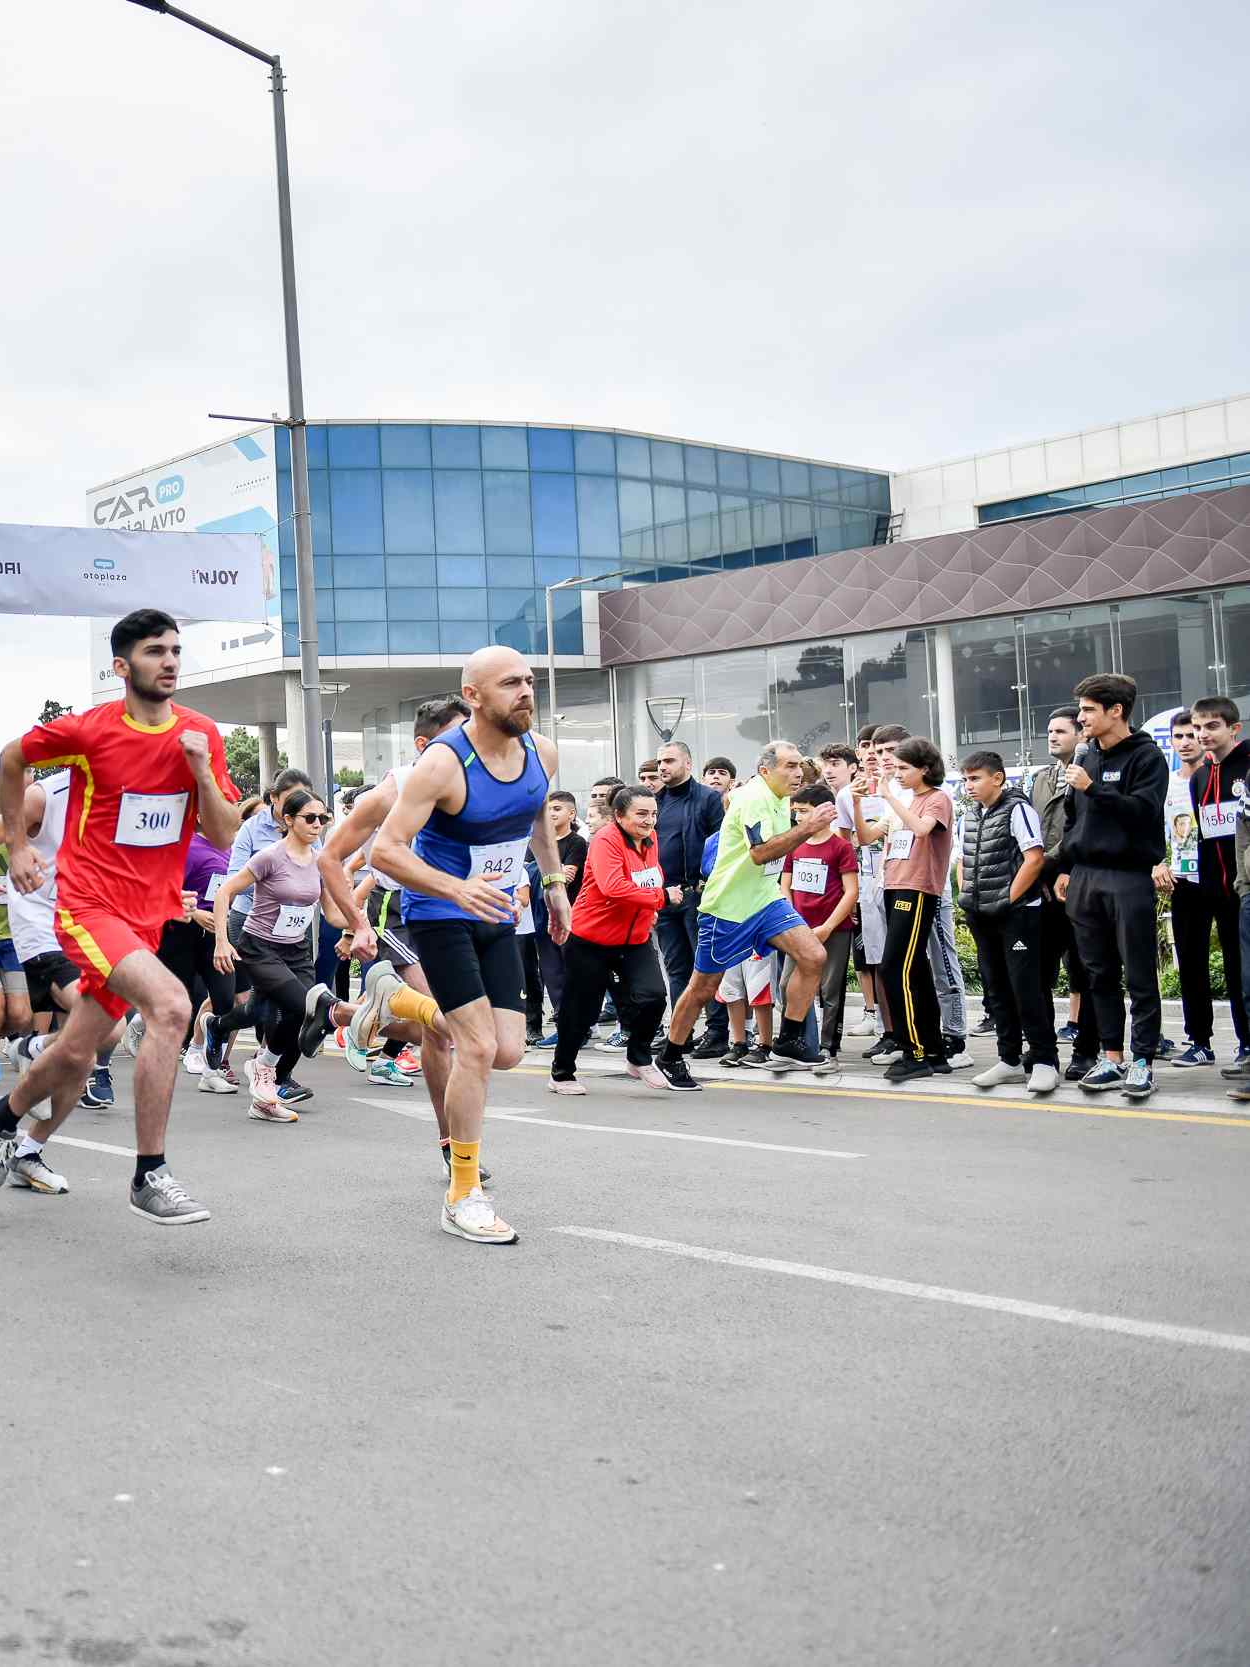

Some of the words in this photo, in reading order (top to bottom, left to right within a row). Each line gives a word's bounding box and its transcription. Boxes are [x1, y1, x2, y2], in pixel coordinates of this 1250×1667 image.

[94, 487, 155, 525] CAR
[159, 481, 180, 497] PRO
[135, 811, 171, 830] 300
[483, 857, 513, 873] 842
[286, 916, 306, 928] 295
